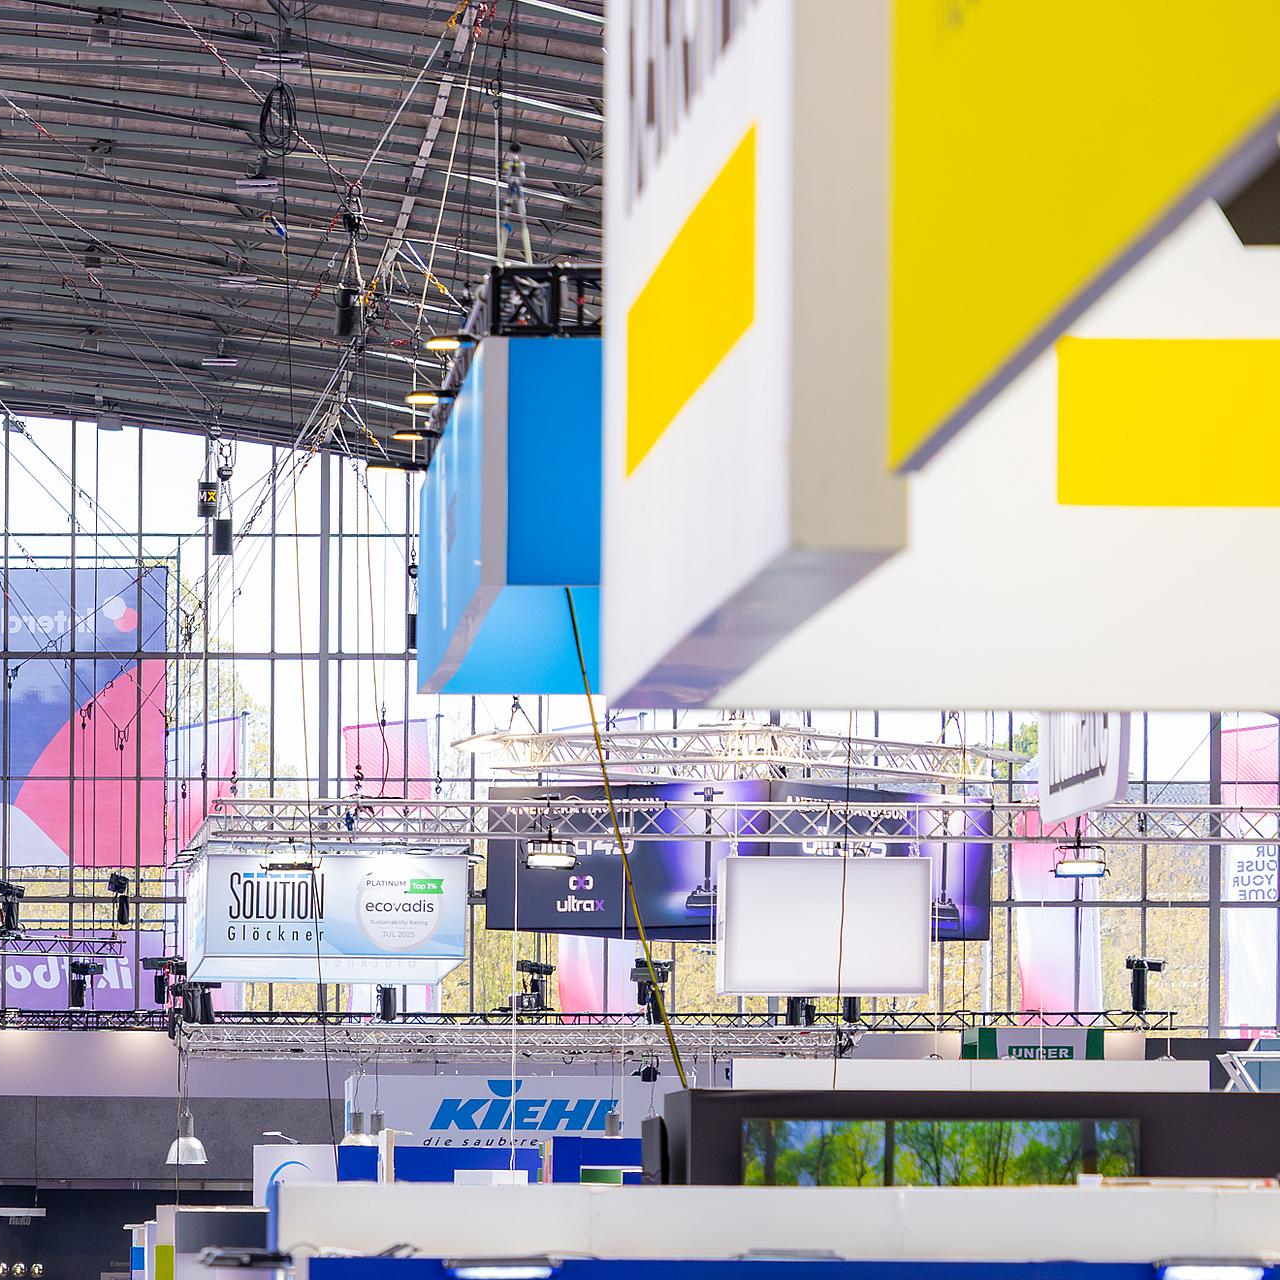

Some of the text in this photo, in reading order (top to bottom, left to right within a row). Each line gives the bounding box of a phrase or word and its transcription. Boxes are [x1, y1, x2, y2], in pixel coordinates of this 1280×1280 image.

[366, 880, 407, 888] PLATINUM
[412, 882, 438, 892] Top 1%
[365, 899, 434, 913] ecovadis
[557, 895, 605, 912] ultrax
[369, 919, 429, 928] Sustainability Rating
[227, 925, 325, 942] Glöckner
[423, 1136, 539, 1147] die saubere
